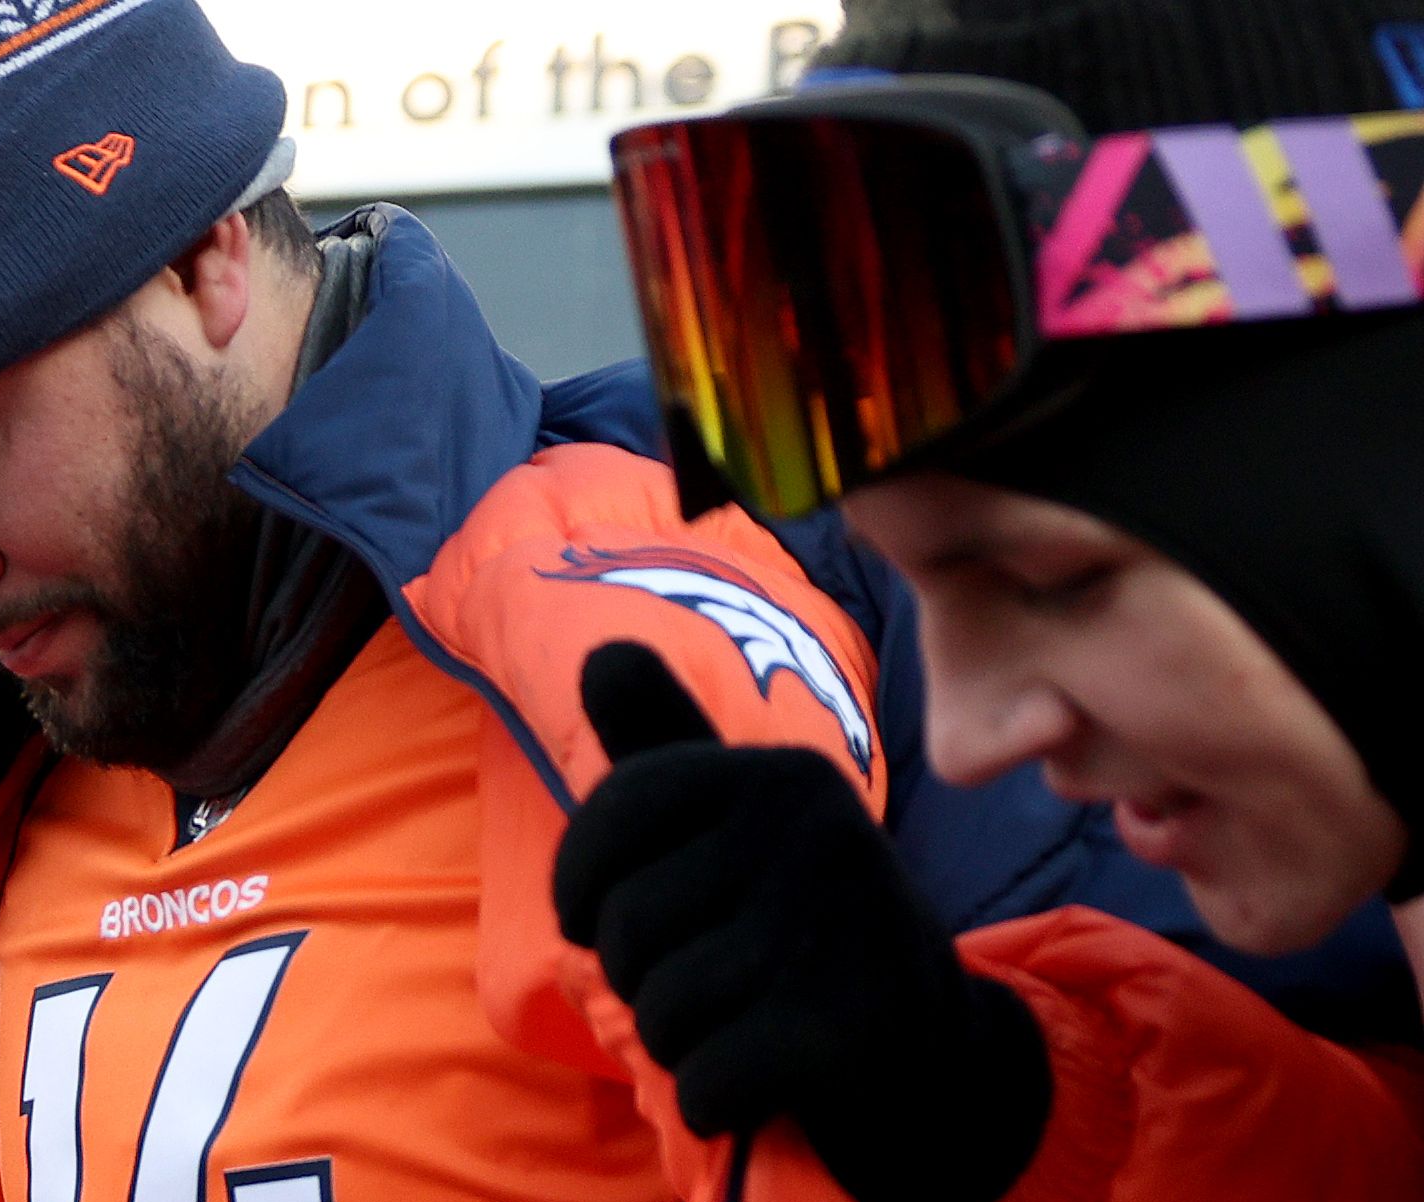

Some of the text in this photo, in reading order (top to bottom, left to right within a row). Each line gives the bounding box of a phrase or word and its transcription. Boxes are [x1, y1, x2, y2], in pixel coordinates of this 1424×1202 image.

[401, 39, 506, 122] of
[547, 32, 715, 115] the
[99, 874, 270, 920] BRONCOS
